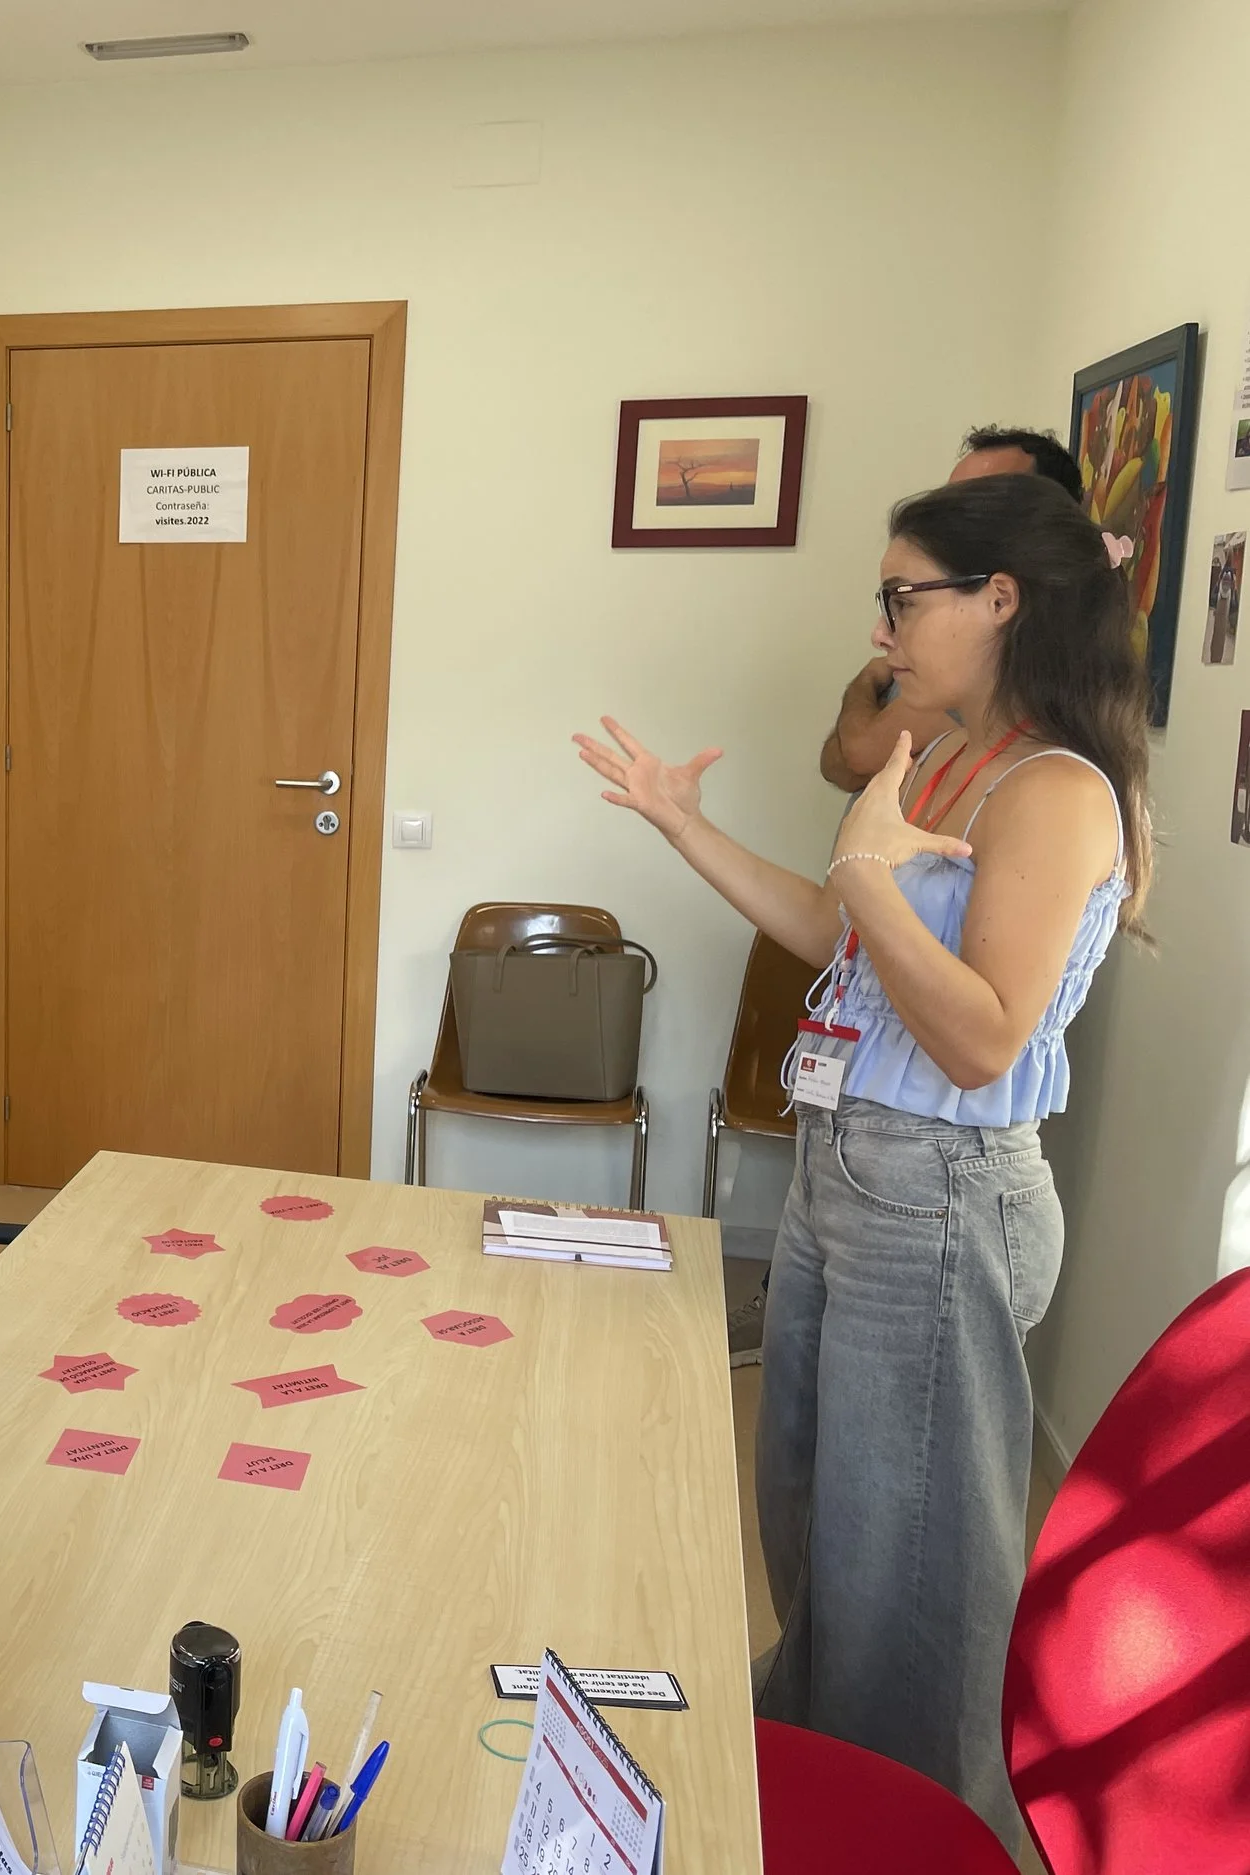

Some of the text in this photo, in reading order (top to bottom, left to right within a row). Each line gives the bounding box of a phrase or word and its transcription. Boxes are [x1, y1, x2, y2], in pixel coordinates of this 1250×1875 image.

[151, 467, 216, 477] WI-FI PÚBLICA
[146, 485, 219, 494] CARITAS-PUBLIC
[156, 502, 209, 510] Contraseña:
[156, 516, 209, 525] visites.2022
[272, 1377, 320, 1390] INTIMITAT
[302, 1382, 328, 1391] DRET
[65, 1440, 115, 1456] IDENTITAT
[104, 1445, 129, 1456] DRET
[70, 1454, 92, 1463] UNA
[246, 1456, 277, 1468] SALUT
[268, 1460, 294, 1470] DRET
[607, 1673, 650, 1681] identitat
[531, 1802, 536, 1818] 11
[542, 1820, 549, 1840] 12
[554, 1840, 561, 1859] 13
[536, 1782, 590, 1873] 4 5 6 7 8
[525, 1823, 532, 1843] 18
[537, 1843, 544, 1863] 19
[519, 1846, 528, 1867] 25
[591, 1833, 611, 1870] 1 2
